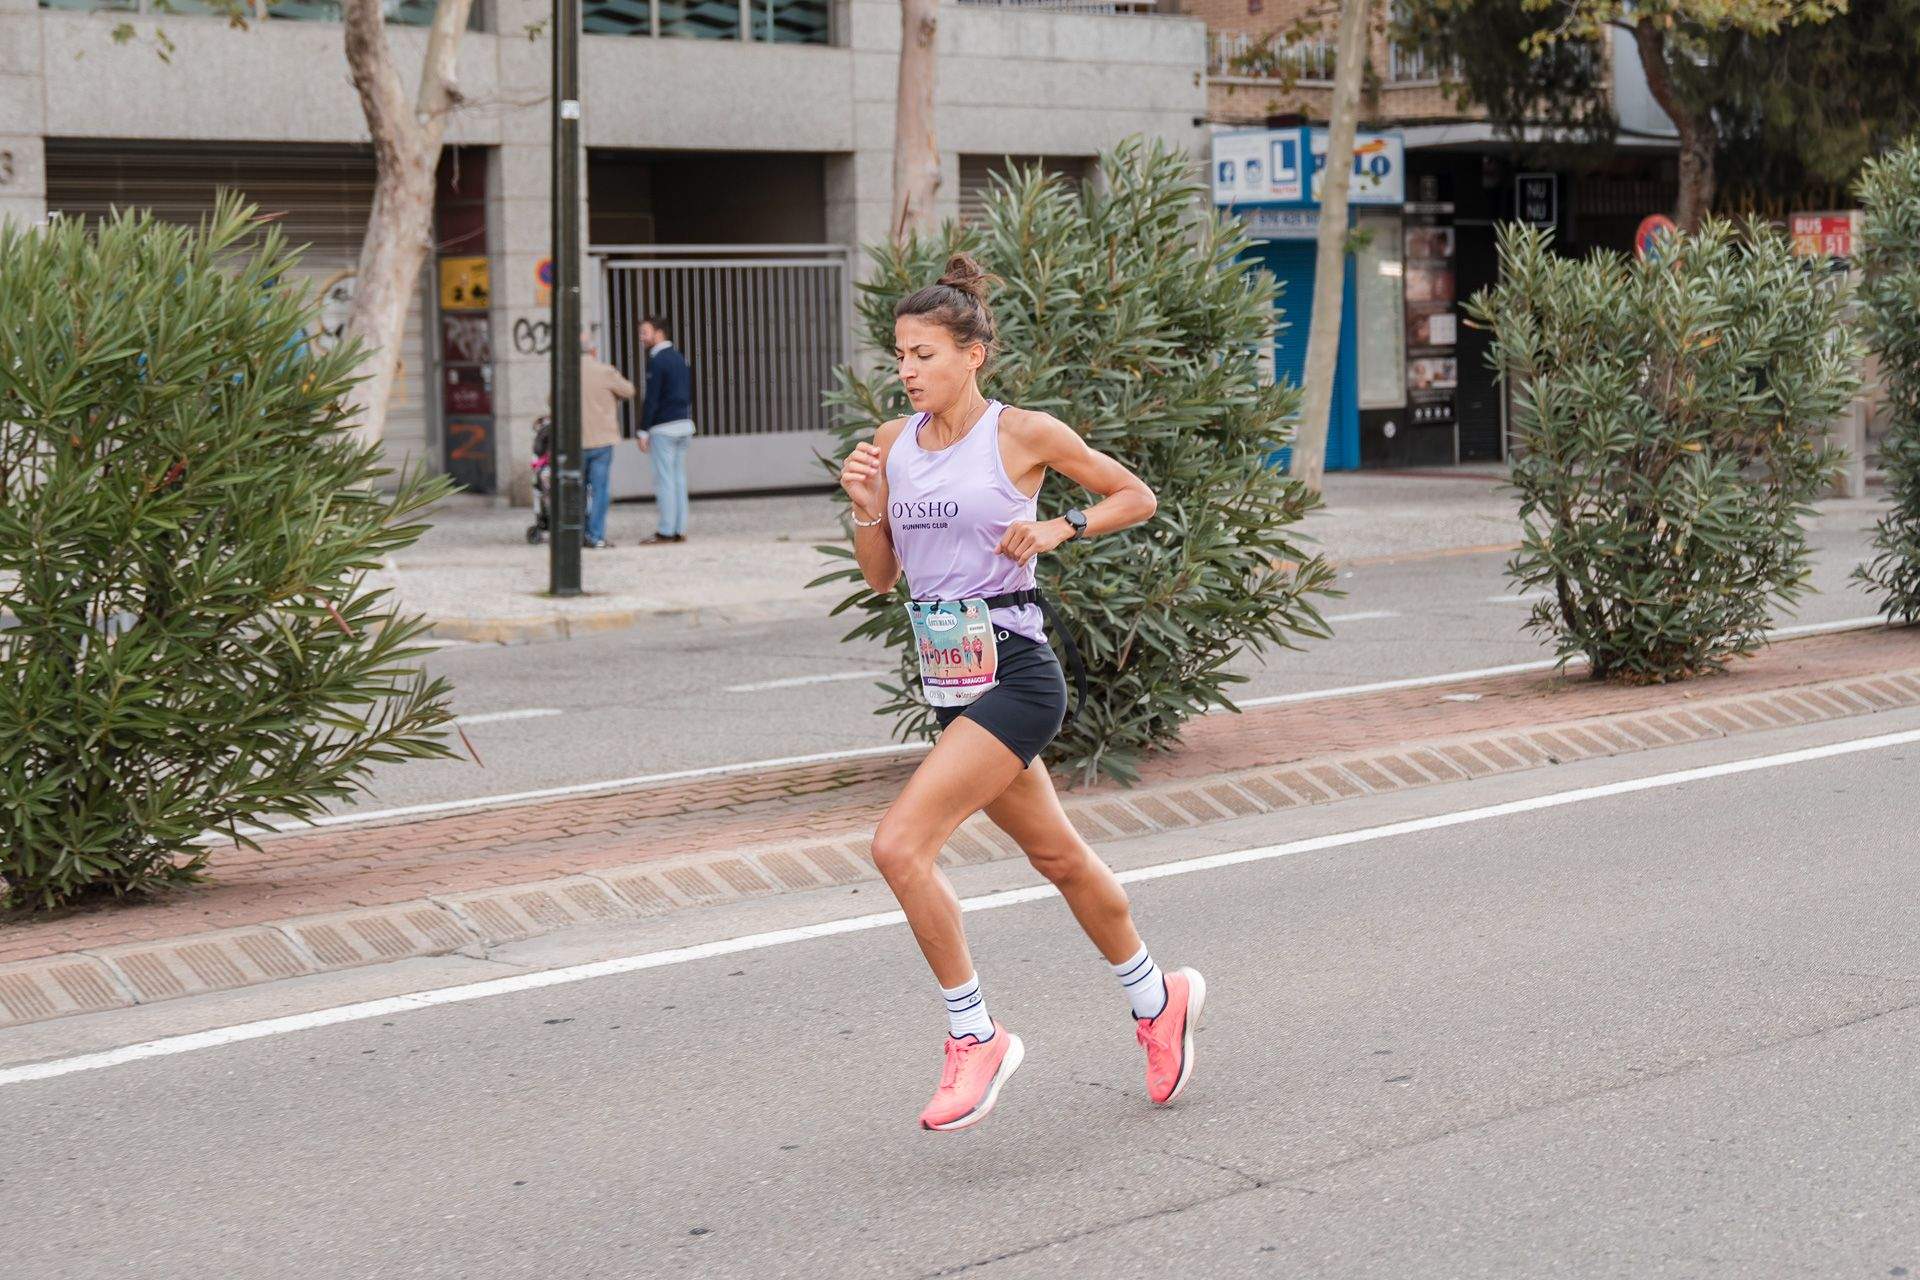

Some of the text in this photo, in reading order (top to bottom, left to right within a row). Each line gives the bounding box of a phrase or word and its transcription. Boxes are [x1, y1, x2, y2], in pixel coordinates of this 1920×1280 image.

[1794, 217, 1822, 234] BUS
[891, 501, 959, 519] OYSHO
[902, 522, 949, 531] RUNNING CLUB
